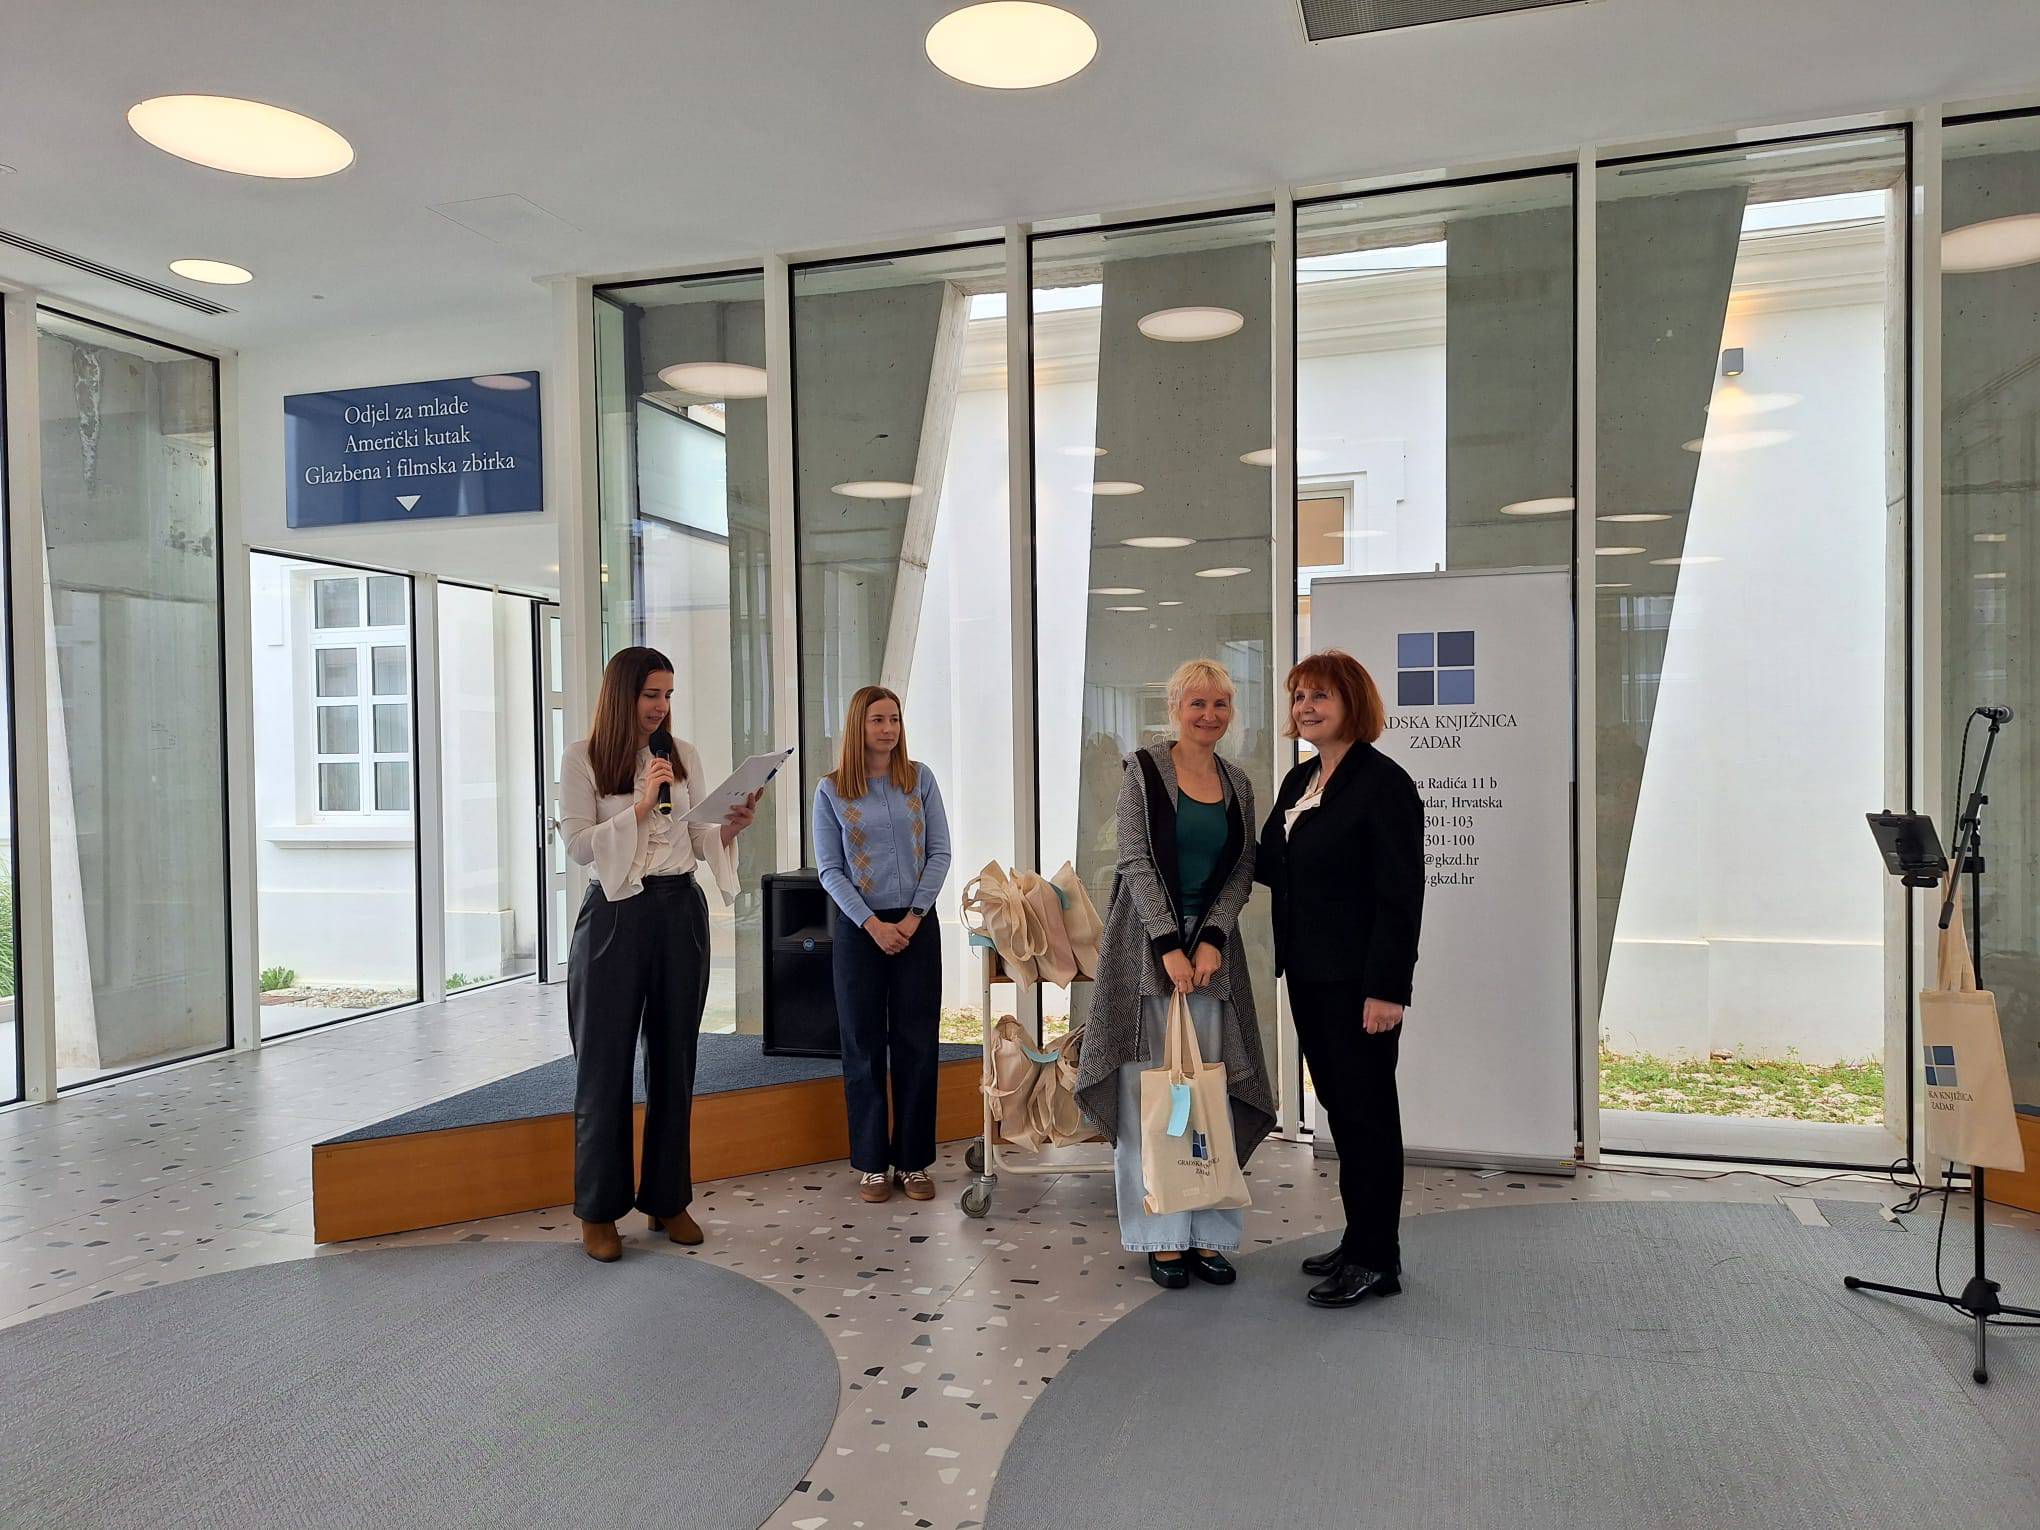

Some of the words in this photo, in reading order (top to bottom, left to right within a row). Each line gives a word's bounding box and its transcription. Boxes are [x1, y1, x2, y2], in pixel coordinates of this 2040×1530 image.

[344, 402, 390, 428] Odjel
[395, 406, 413, 420] za
[418, 395, 469, 418] mlade
[344, 429, 420, 453] Američki
[424, 425, 471, 446] kutak
[305, 463, 381, 485] Glazbena
[386, 460, 391, 478] i
[397, 456, 457, 477] filmska
[462, 451, 515, 472] zbirka
[1435, 711, 1518, 731] KNJIŽNICA
[1410, 735, 1462, 749] ZADAR
[1428, 777, 1467, 789] Radića
[1472, 777, 1485, 789] 11
[1489, 777, 1497, 789] b
[1452, 796, 1503, 808] Hrvatska
